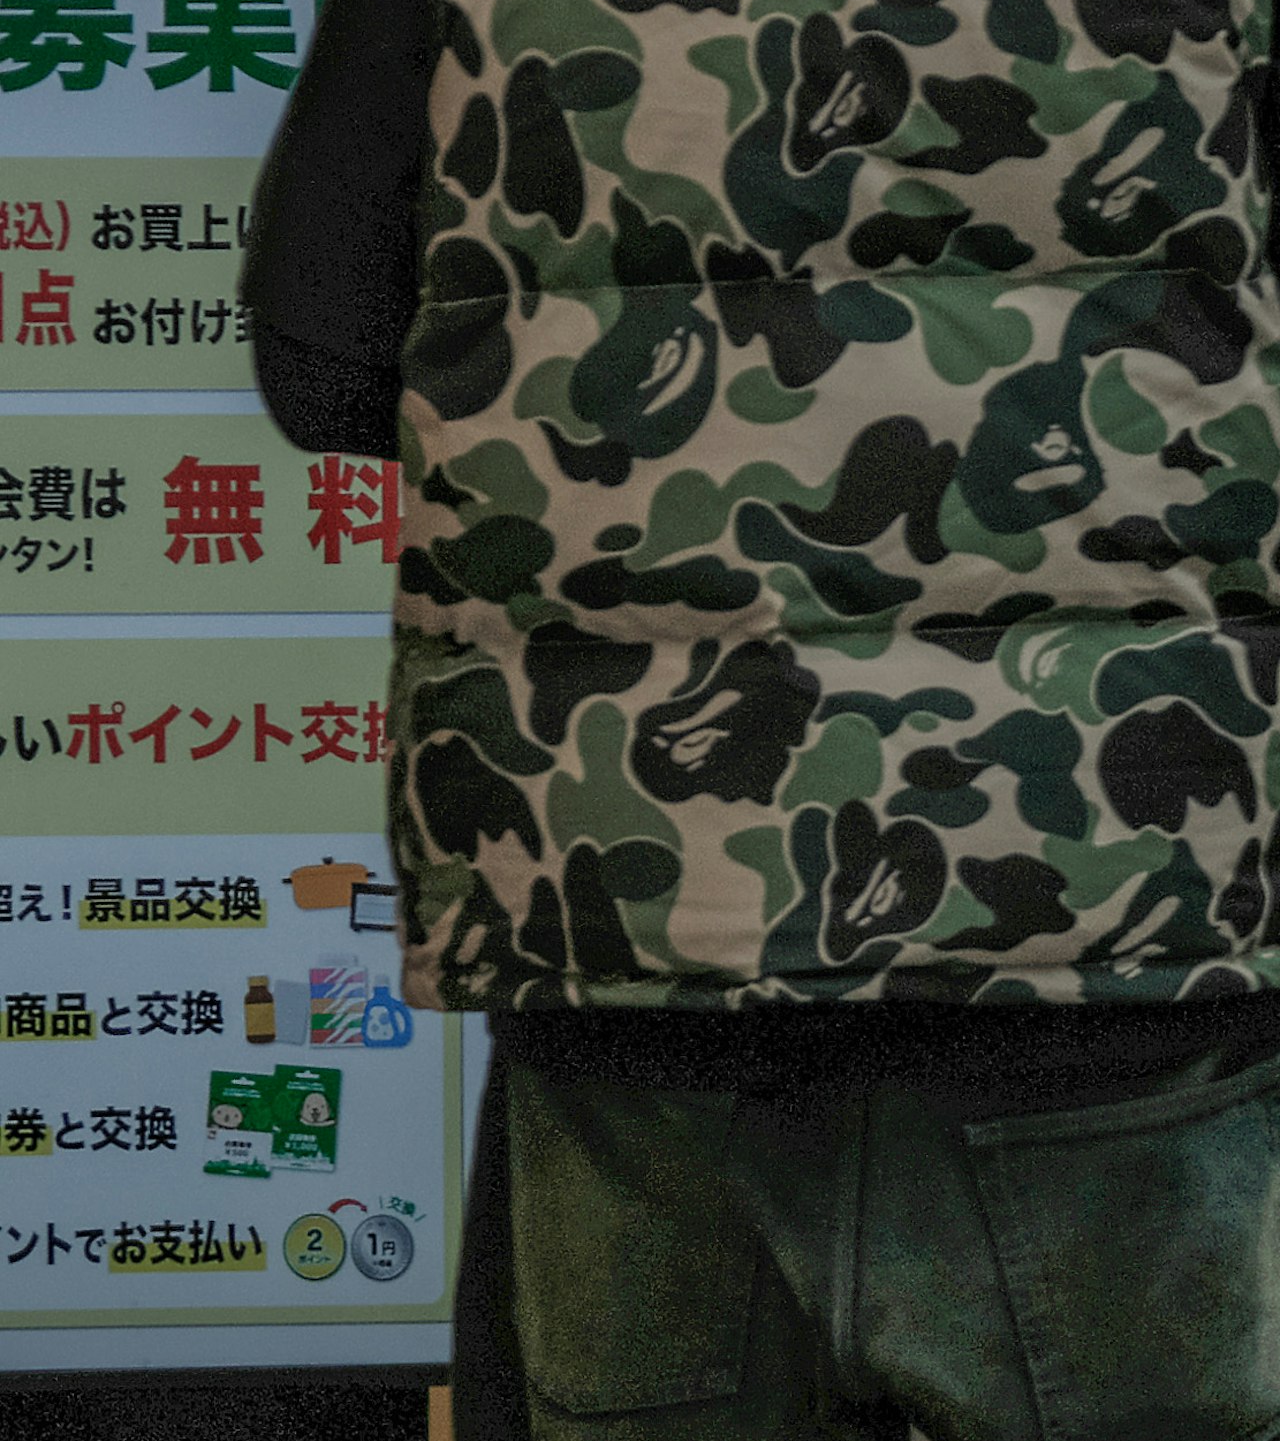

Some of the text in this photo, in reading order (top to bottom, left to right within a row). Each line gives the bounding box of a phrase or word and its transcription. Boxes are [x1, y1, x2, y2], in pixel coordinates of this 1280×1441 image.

[0, 269, 76, 345] 点
[0, 536, 94, 572] タン!
[0, 699, 388, 765] いポイント交
[5, 991, 224, 1037] 商品と交換
[5, 1106, 177, 1152] 券と交換
[307, 1229, 322, 1252] 2
